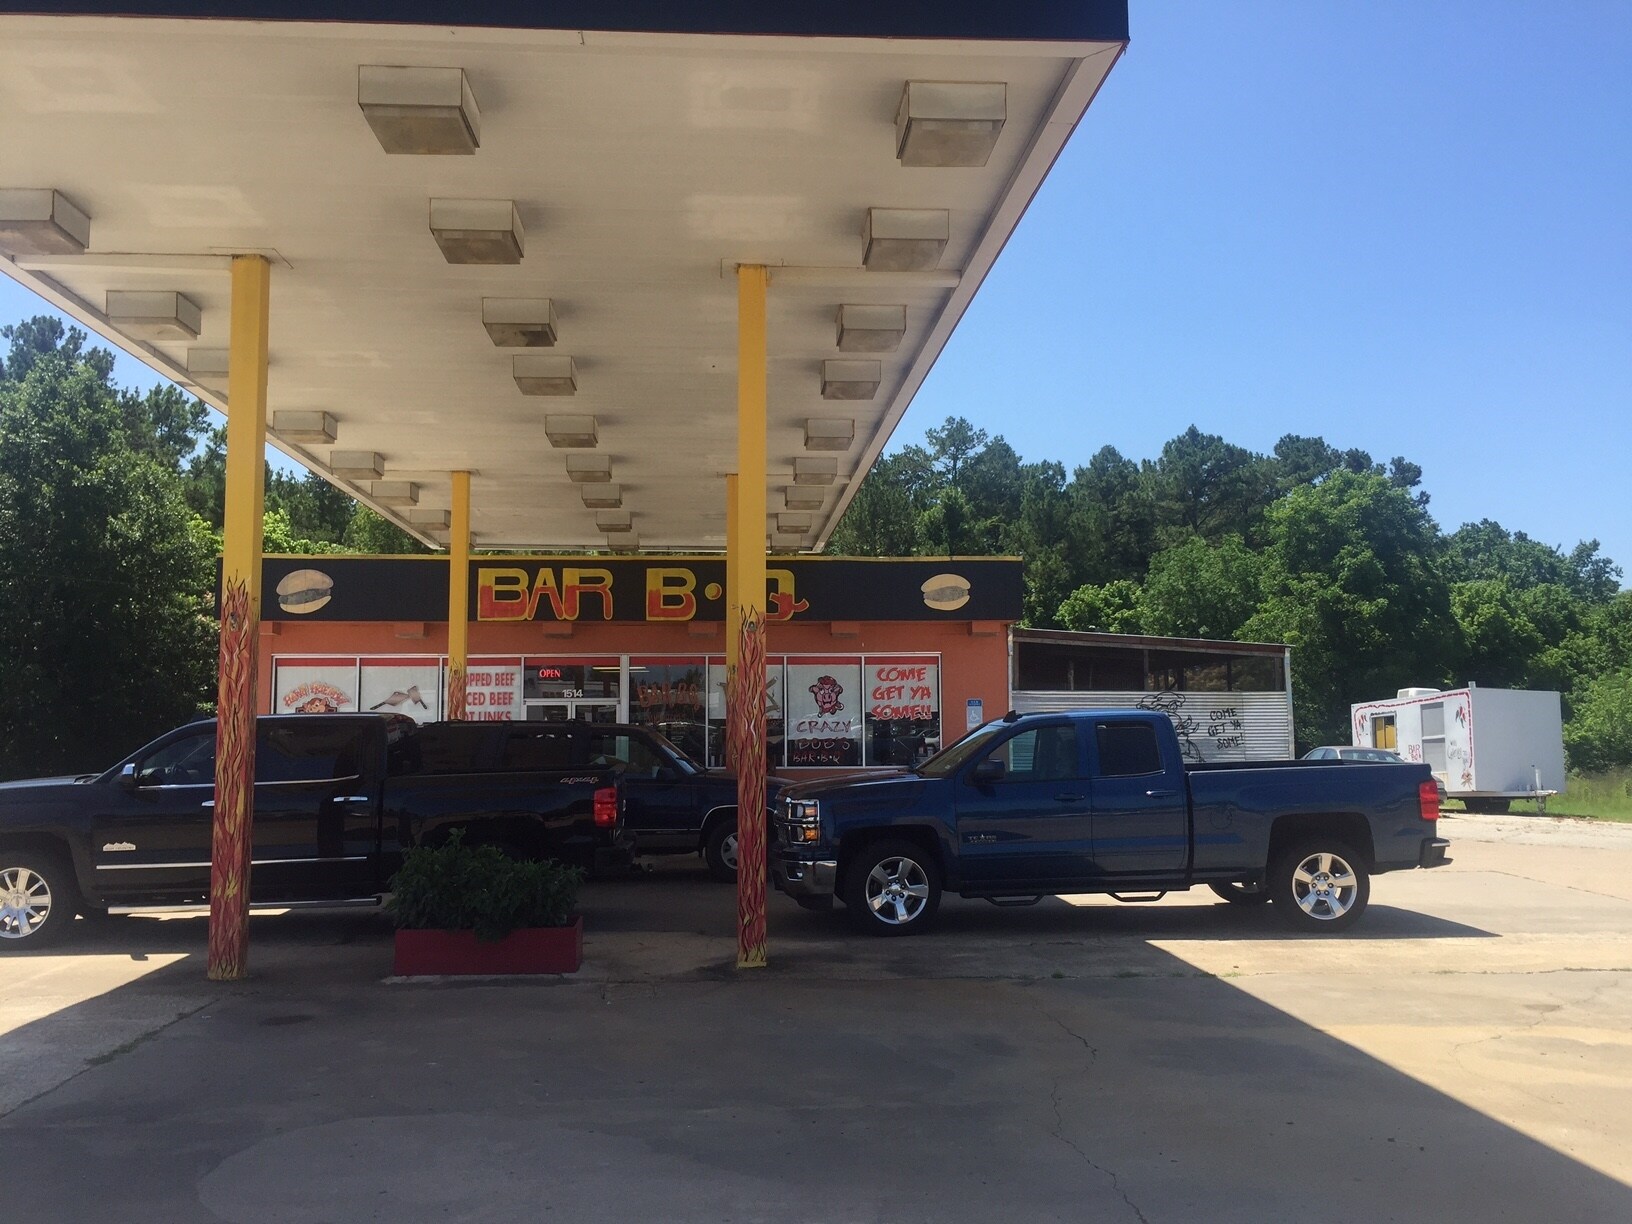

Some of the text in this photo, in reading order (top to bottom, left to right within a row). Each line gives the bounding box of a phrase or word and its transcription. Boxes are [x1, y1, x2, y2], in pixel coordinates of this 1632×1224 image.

[478, 567, 613, 621] BAR
[495, 672, 516, 687] BEEF
[538, 668, 561, 678] OPEN
[876, 667, 927, 682] COME
[489, 691, 514, 706] BEEF
[562, 689, 583, 698] 1514
[872, 685, 932, 701] GET YA
[871, 704, 933, 720] SOME!!
[1210, 708, 1237, 721] COME
[796, 720, 852, 734] CRAZY
[1208, 722, 1227, 736] GET
